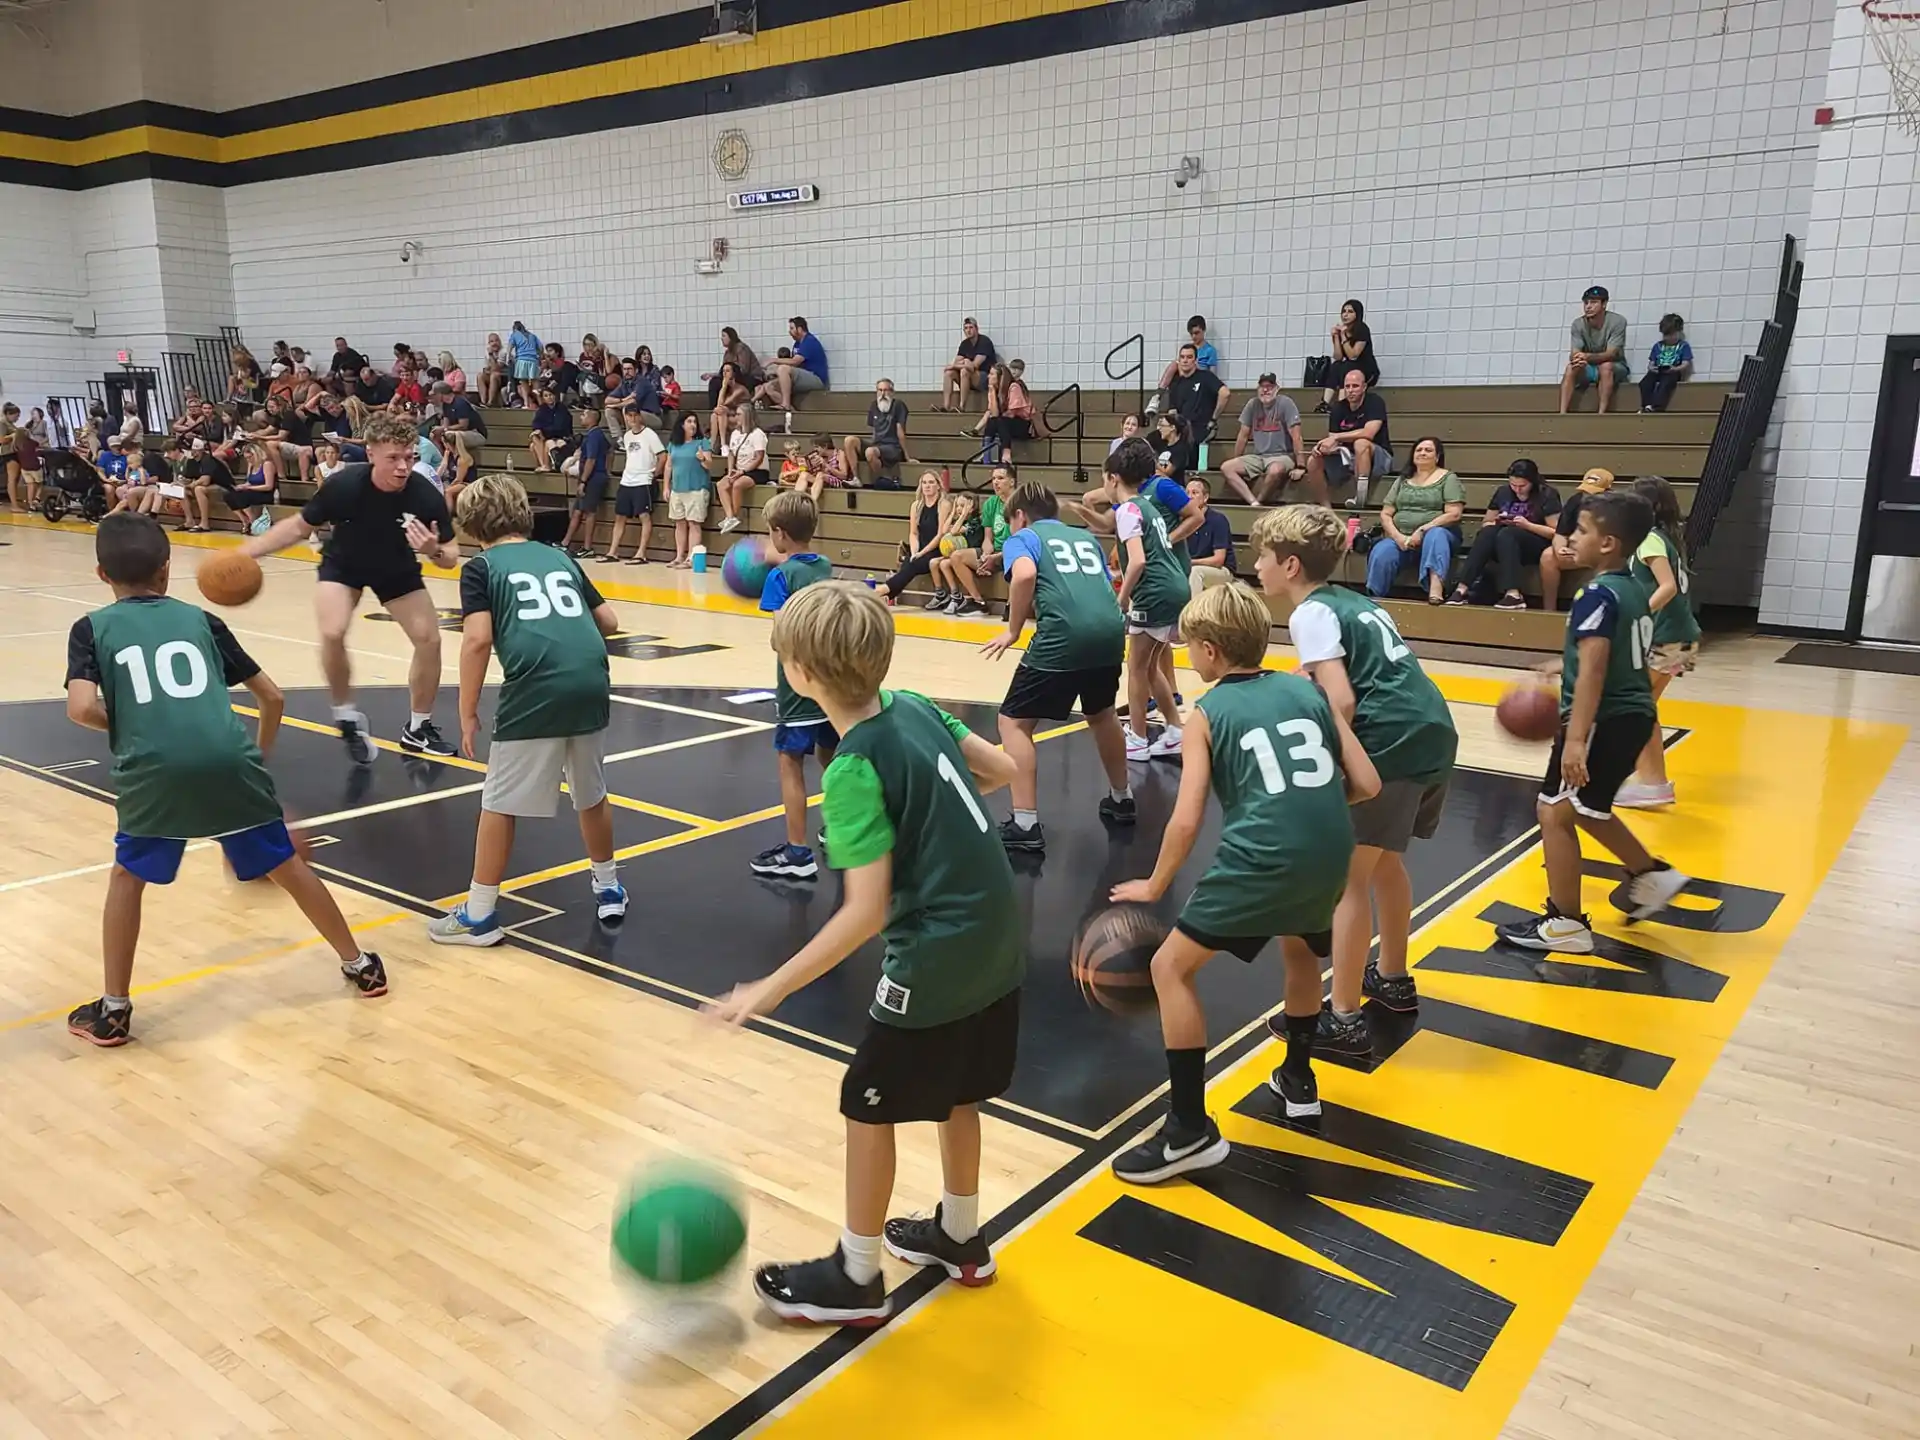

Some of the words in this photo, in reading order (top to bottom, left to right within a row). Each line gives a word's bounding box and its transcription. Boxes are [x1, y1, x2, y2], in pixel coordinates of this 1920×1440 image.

[756, 193, 768, 203] PM
[1047, 538, 1102, 575] 35
[508, 571, 583, 620] 36
[115, 641, 208, 704] 10
[1240, 718, 1335, 795] 13
[937, 752, 989, 833] 1
